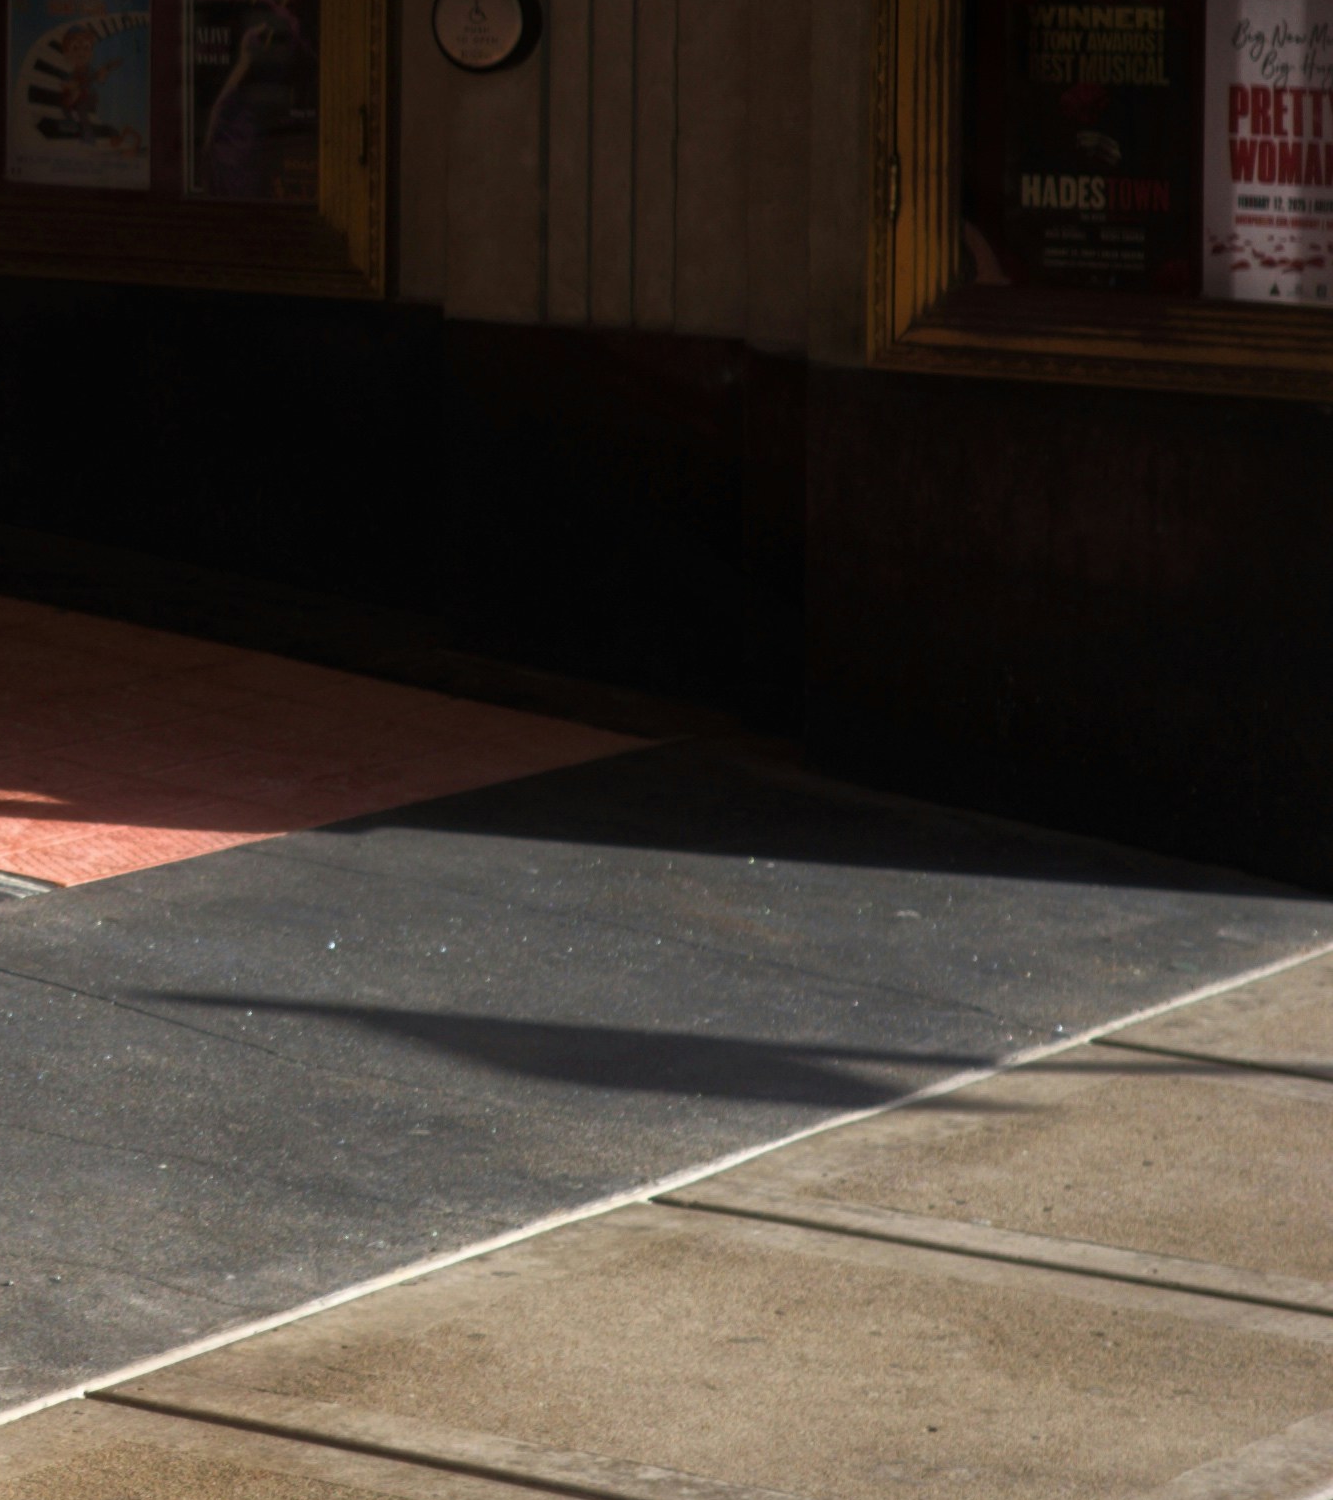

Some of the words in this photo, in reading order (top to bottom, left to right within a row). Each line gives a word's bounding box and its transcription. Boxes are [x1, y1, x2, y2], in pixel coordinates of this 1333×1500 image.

[1030, 5, 1165, 30] WINNER!
[1043, 30, 1083, 51] TONY
[1088, 31, 1156, 53] AWARDS
[1231, 18, 1265, 63] Big
[1077, 54, 1169, 87] MUSICAL
[1229, 84, 1333, 139] PRETT
[1020, 172, 1171, 213] HADESTOWN
